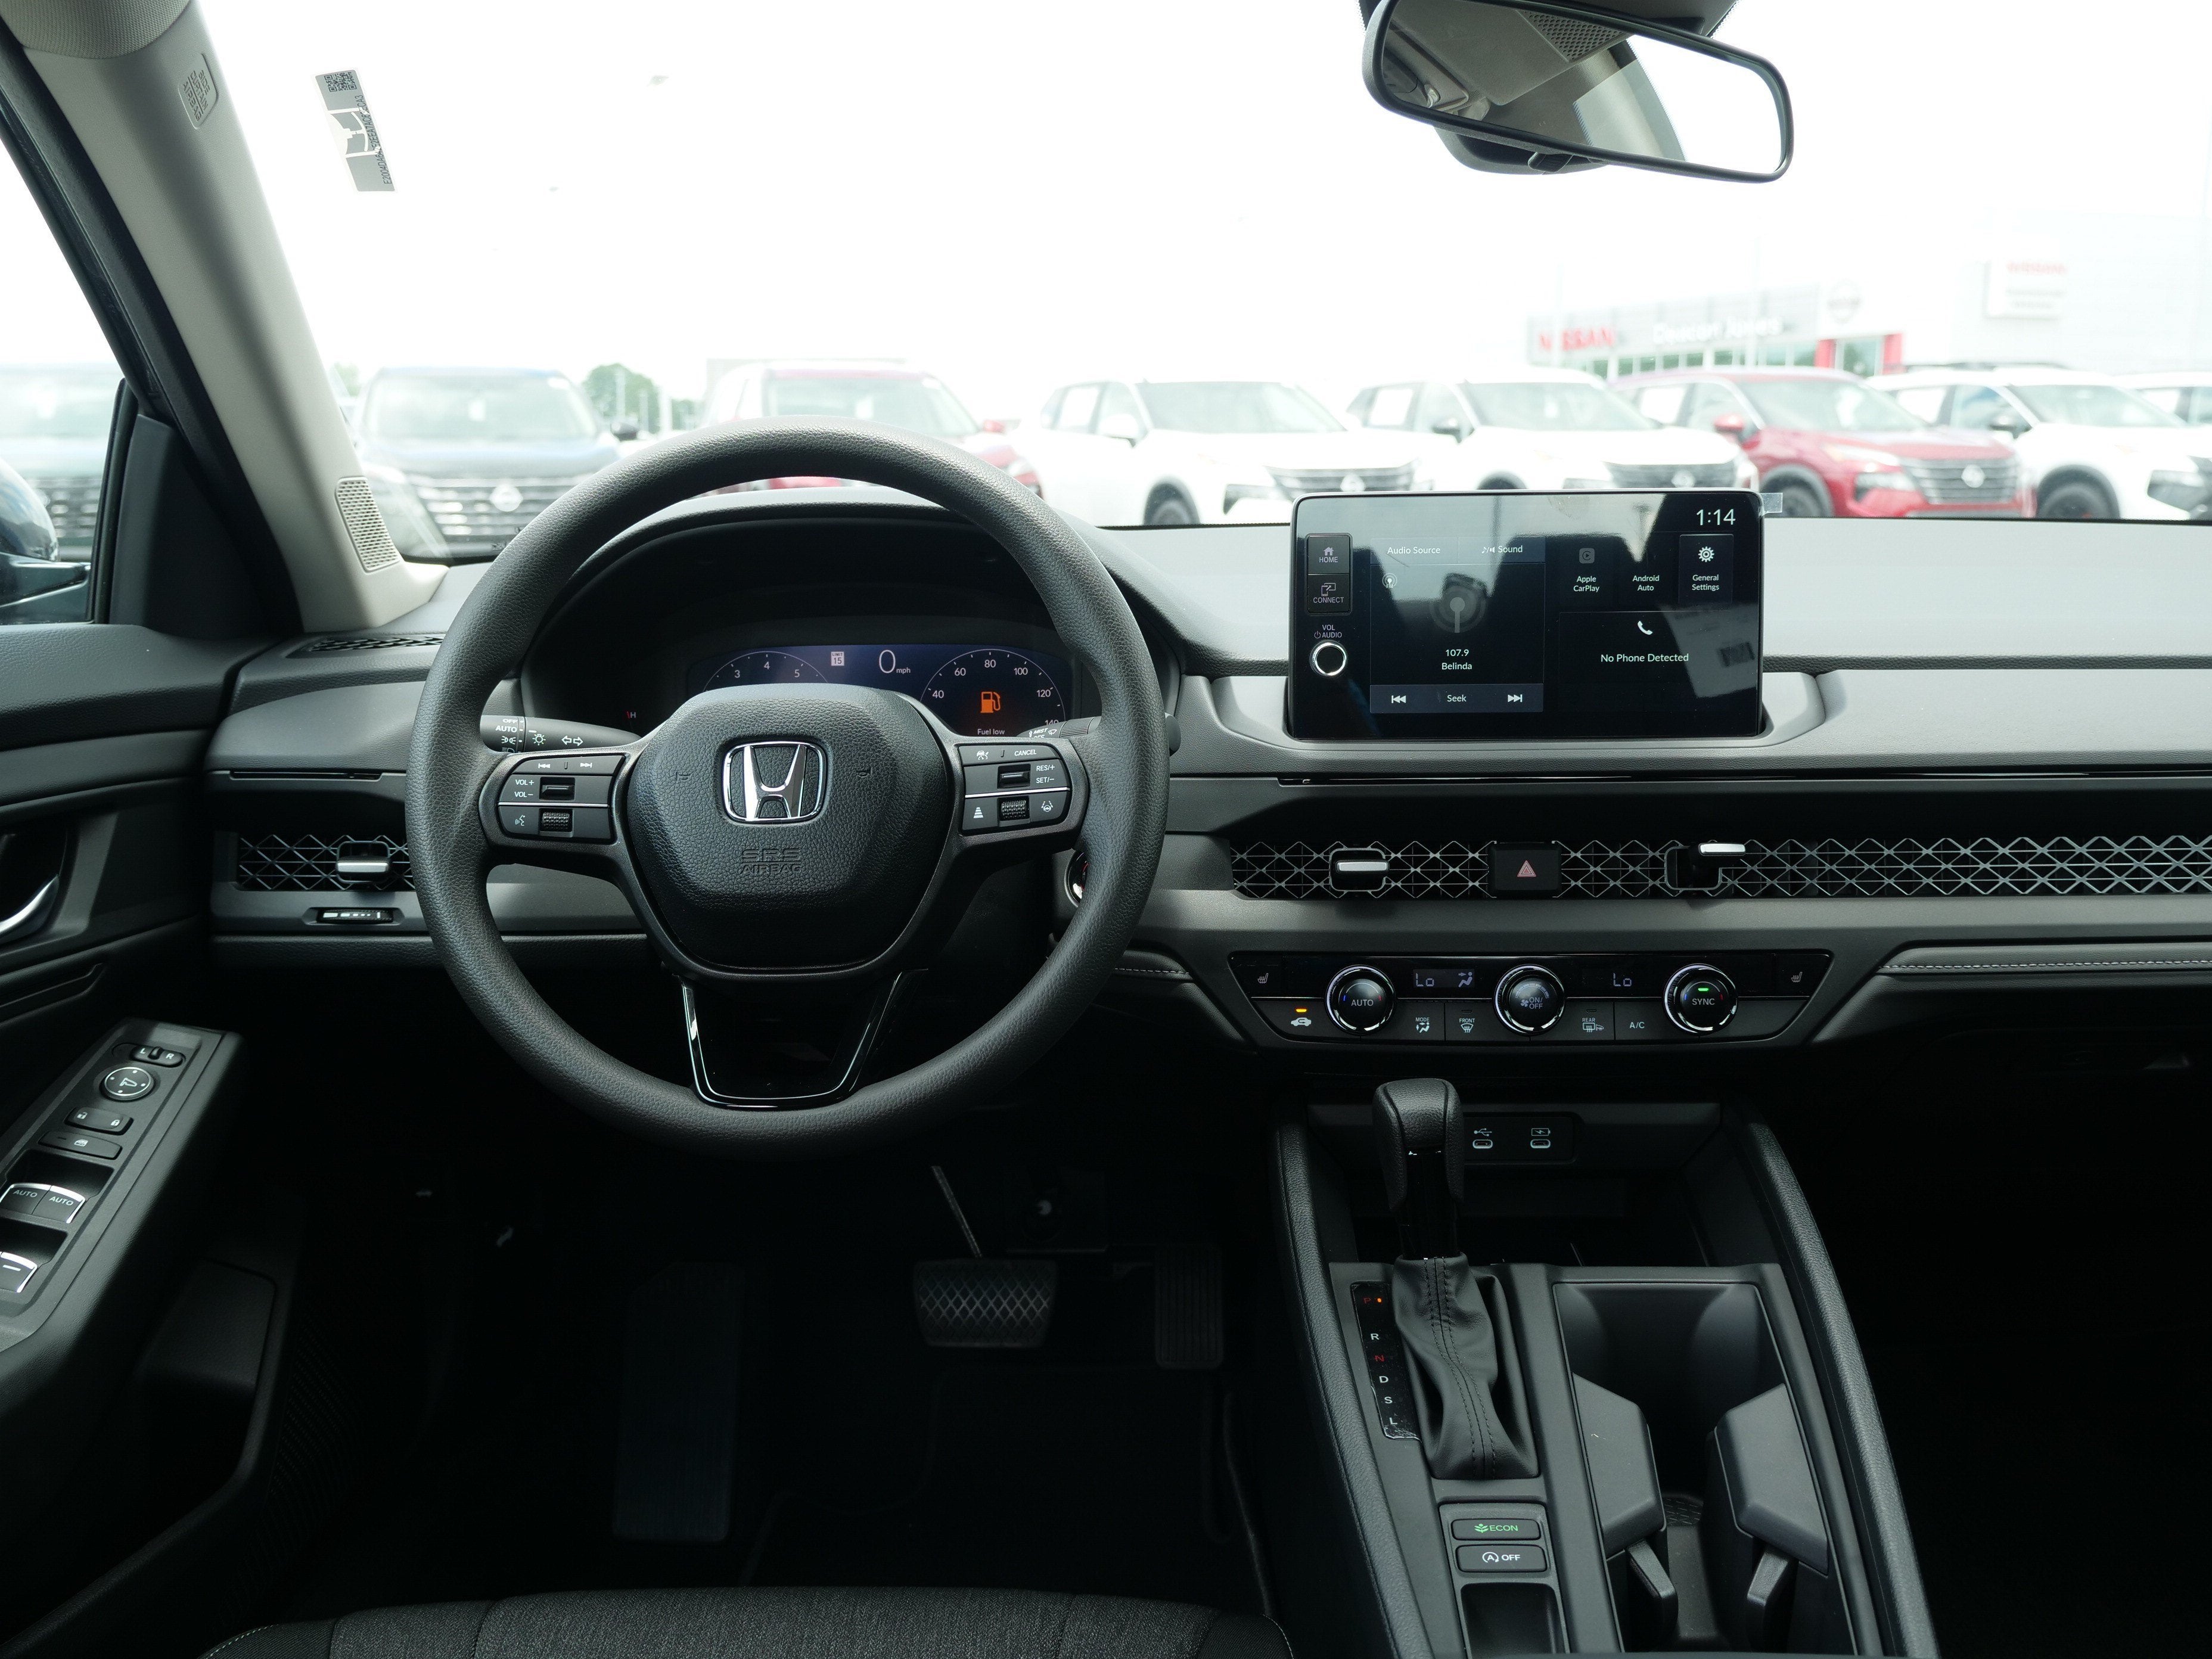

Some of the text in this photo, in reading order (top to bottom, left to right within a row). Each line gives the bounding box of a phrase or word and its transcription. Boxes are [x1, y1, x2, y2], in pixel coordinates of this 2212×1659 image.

[1696, 509, 1736, 526] 1:14
[1387, 546, 1441, 555] Audio Source
[1577, 576, 1596, 584] Apple
[1573, 585, 1599, 593] CarPlay
[1692, 583, 1719, 592] Settings
[879, 650, 896, 674] 0
[1601, 653, 1689, 663] No Phone Detected
[763, 661, 771, 670] 4
[984, 659, 996, 668] 80
[1441, 662, 1472, 670] Belinda
[734, 670, 741, 678] 3
[794, 669, 800, 678] 5
[954, 668, 967, 676] 60
[1013, 667, 1029, 675] 100
[932, 690, 945, 699] 40
[1036, 689, 1051, 698] 120
[1447, 694, 1467, 703] Seek
[742, 849, 801, 862] SRS
[742, 865, 802, 874] AIRBAG
[1351, 998, 1374, 1007] AUTO
[1692, 997, 1716, 1006] SYNC
[1629, 1021, 1645, 1030] A/C
[13, 1189, 38, 1198] AUTO
[49, 1195, 74, 1206] AUTO
